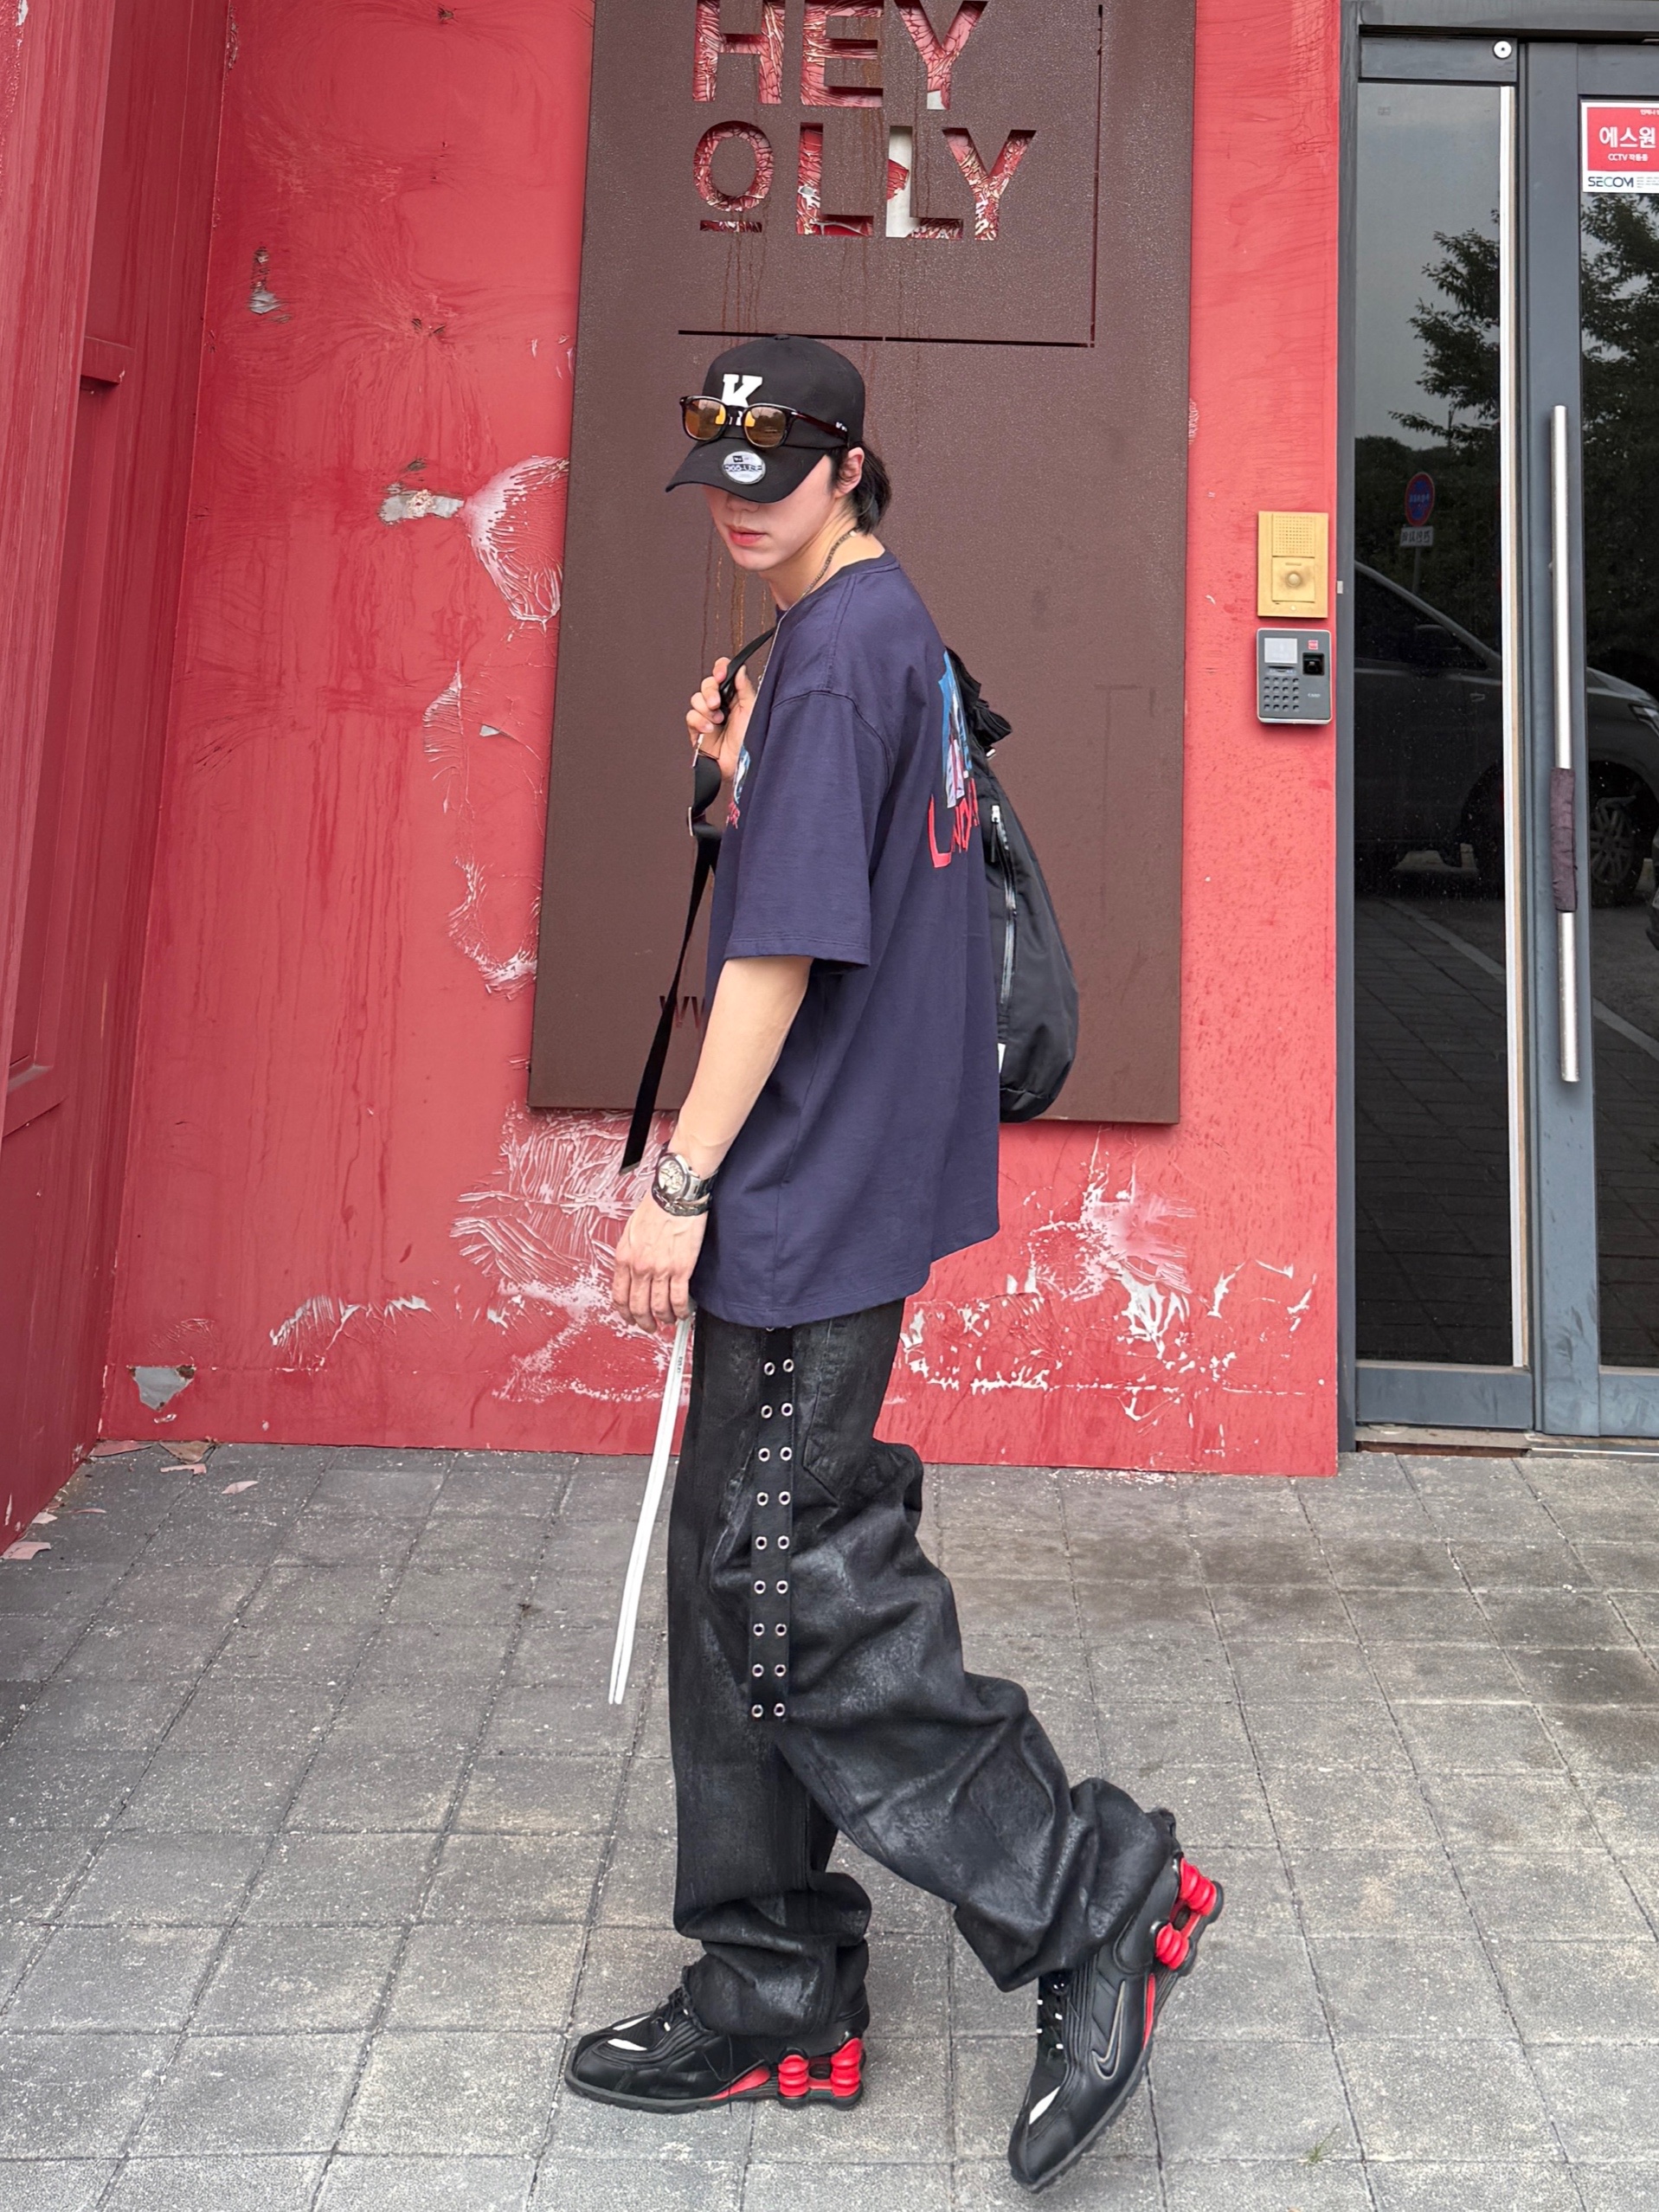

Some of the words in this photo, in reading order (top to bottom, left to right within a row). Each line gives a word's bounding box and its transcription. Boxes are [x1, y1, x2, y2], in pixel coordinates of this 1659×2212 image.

[693, 0, 987, 110] HEY
[1598, 126, 1656, 149] 에스원
[1608, 153, 1628, 162] CCTV
[693, 120, 1036, 241] OLLY
[1588, 177, 1634, 188] SECOM
[716, 373, 763, 427] K
